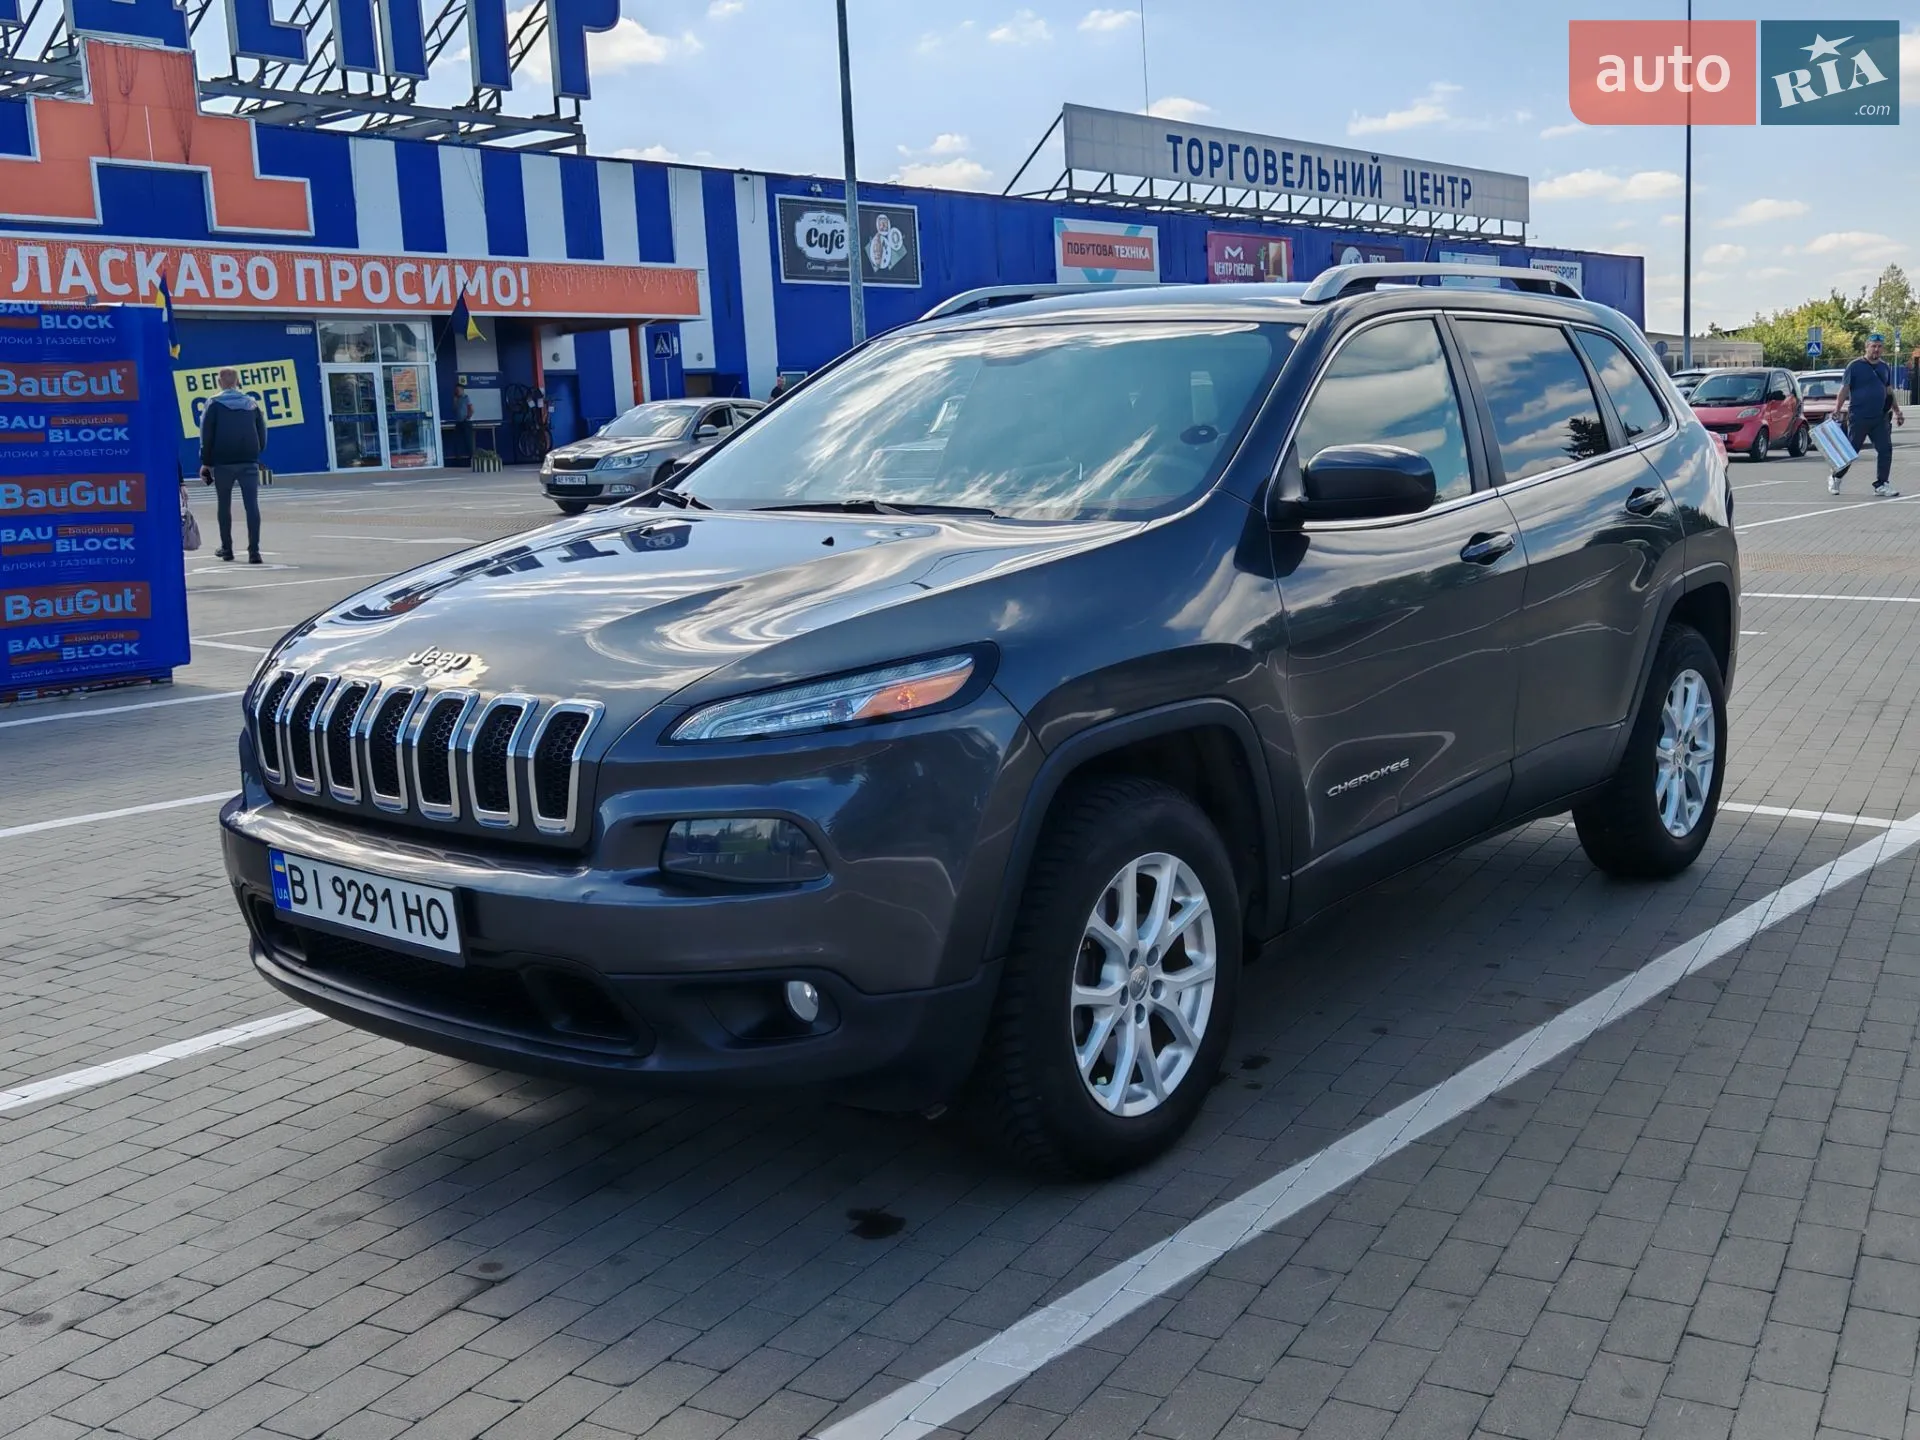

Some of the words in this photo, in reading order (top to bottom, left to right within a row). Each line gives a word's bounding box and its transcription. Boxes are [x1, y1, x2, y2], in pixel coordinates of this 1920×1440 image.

[1166, 134, 1382, 199] ТОРГОВЕЛЬНИЙ
[1403, 168, 1472, 209] ЦЕНТР
[805, 227, 845, 255] Café
[1067, 242, 1114, 257] ПОБУТОВА
[1114, 245, 1150, 259] ТЕХНІКА
[12, 246, 279, 300] ЛАСКАВО
[294, 259, 532, 307] ПРОСИМО!
[41, 315, 114, 329] BLOCK
[0, 368, 124, 397] BauGut
[186, 375, 198, 392] В
[48, 427, 130, 443] BLOCK
[0, 480, 132, 510] BauGut
[0, 526, 53, 543] BAU
[55, 537, 136, 553] BLOCK
[5, 588, 137, 622] BauGut
[8, 634, 61, 654] BAU
[62, 642, 141, 660] BLOCK
[408, 645, 471, 673] Jeep
[1327, 758, 1410, 797] CHEROKEE
[276, 887, 289, 901] UA
[287, 864, 323, 910] BI
[331, 876, 398, 930] 9291
[404, 891, 449, 940] HO
